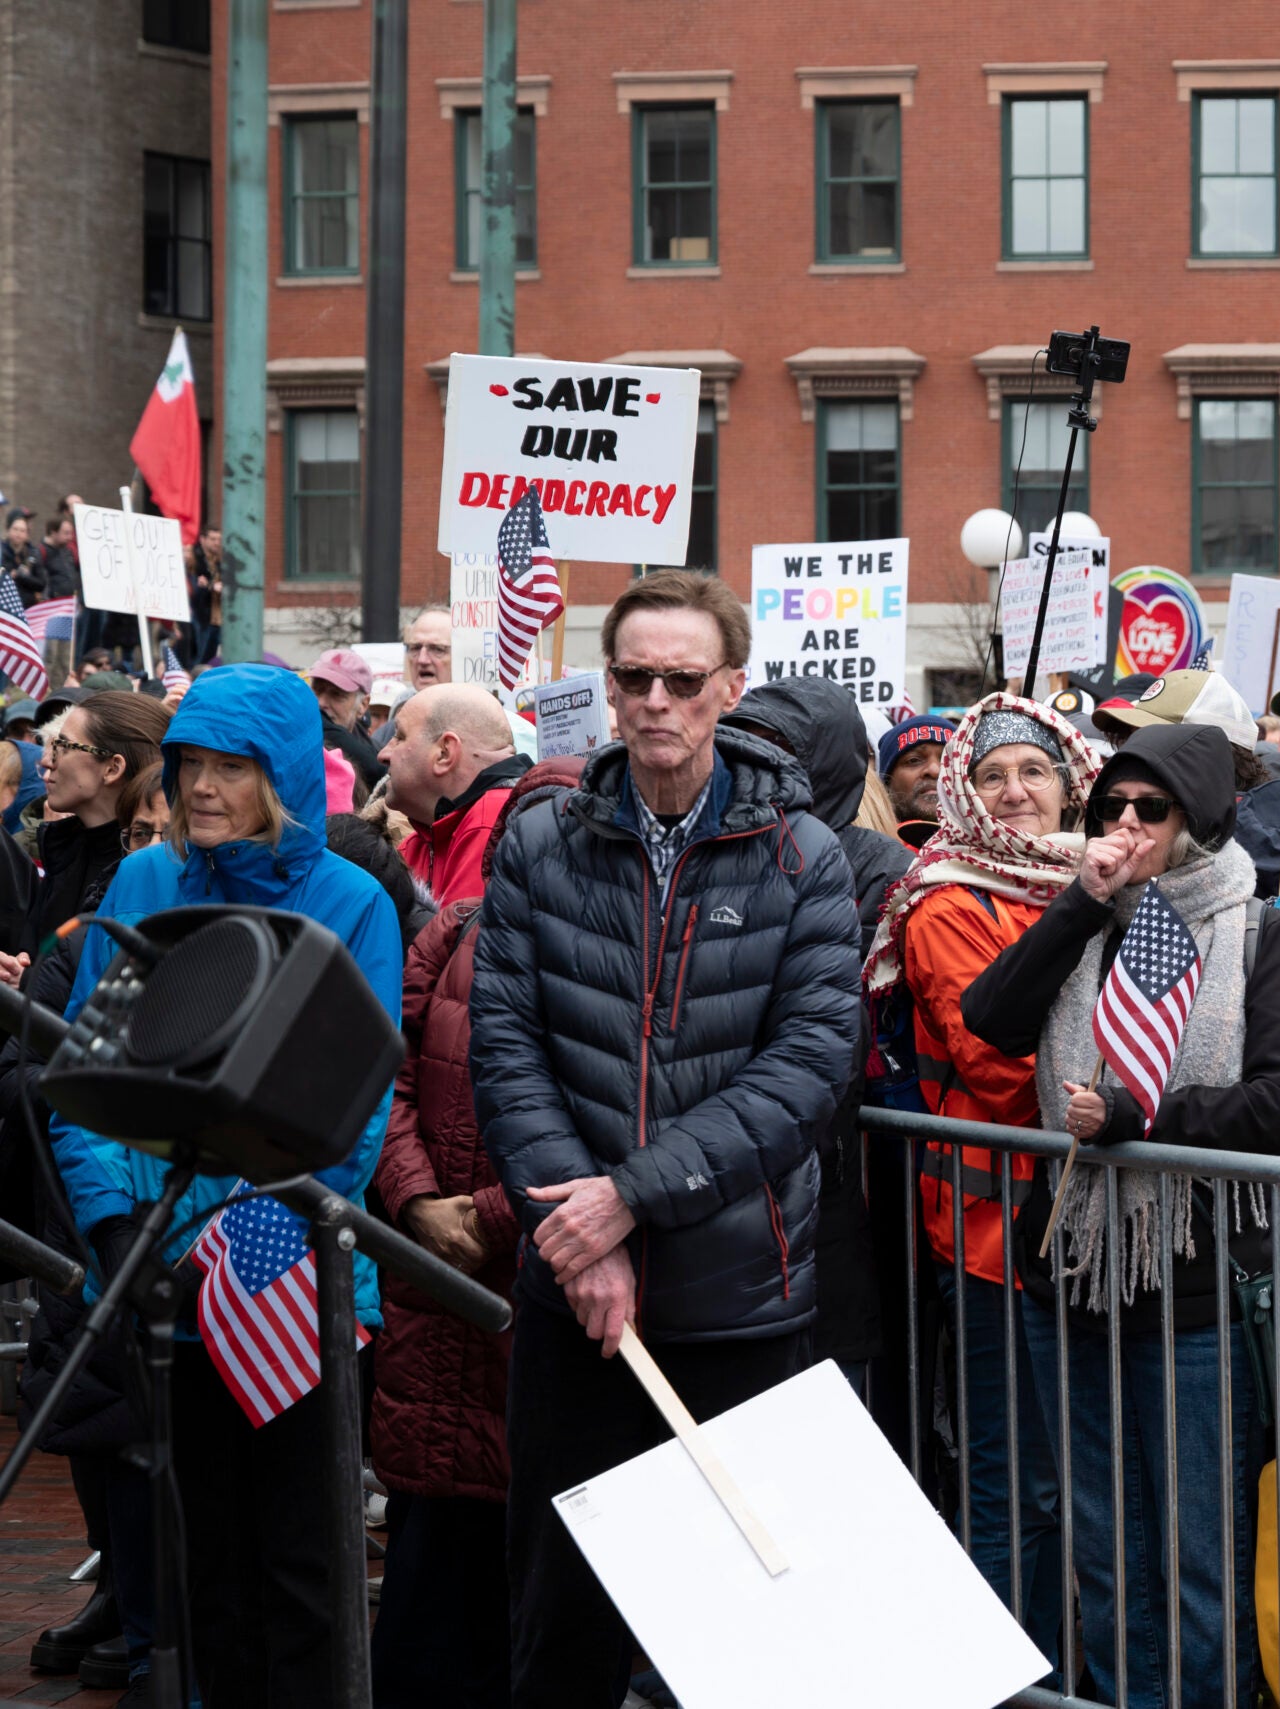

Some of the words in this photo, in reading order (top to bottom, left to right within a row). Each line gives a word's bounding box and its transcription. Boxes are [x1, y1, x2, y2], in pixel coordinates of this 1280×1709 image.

[512, 377, 641, 417] SAVE
[521, 425, 618, 463] OUR
[458, 472, 676, 525] DEMOCRACY
[83, 509, 121, 542] GET
[134, 518, 171, 550] OUT
[97, 544, 123, 581] OF
[141, 550, 179, 588] OGE
[784, 556, 822, 577] WE
[838, 552, 893, 575] THE
[465, 570, 498, 597] UPHO
[756, 585, 902, 621] PEOPLE
[801, 628, 859, 651] ARE
[1128, 626, 1177, 655] LOVE
[765, 657, 876, 681] WICKED
[541, 696, 571, 714] HANDS
[572, 691, 591, 707] OFF!
[843, 681, 894, 703] SED
[898, 726, 954, 751] BOSTO
